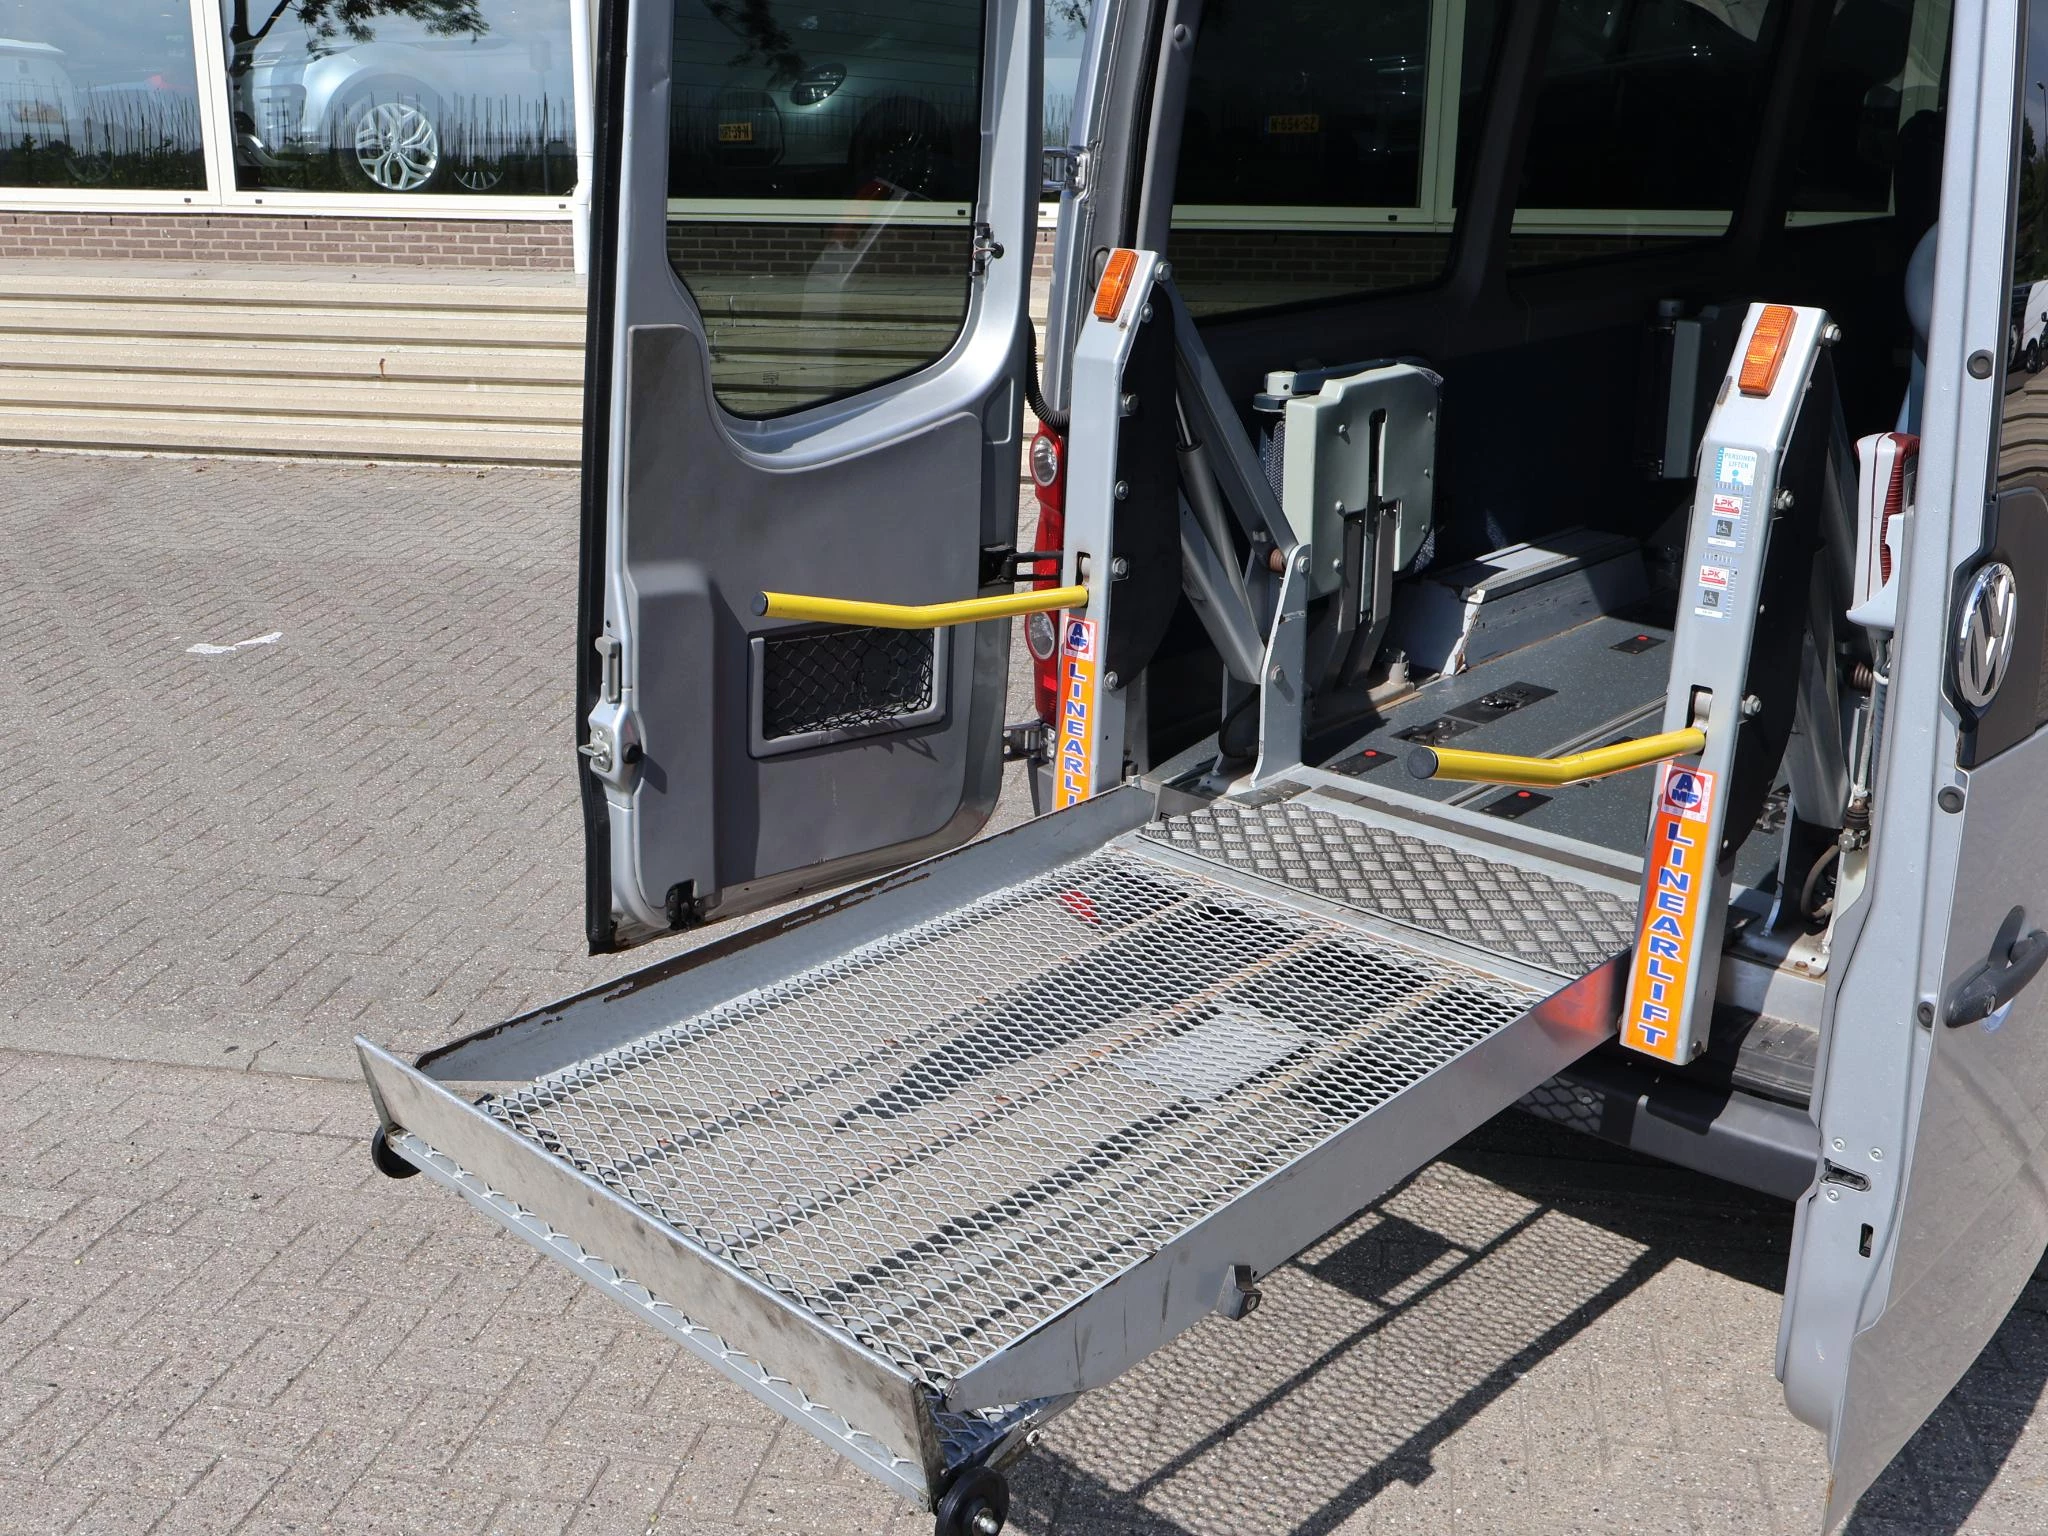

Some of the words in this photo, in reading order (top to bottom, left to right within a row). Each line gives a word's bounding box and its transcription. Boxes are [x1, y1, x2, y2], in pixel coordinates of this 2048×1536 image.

[1724, 452, 1756, 462] PERSONEN
[1728, 461, 1749, 469] LIFTEN
[1715, 498, 1733, 507] LPK
[1702, 569, 1721, 578] LPK
[1672, 773, 1699, 804] AMF
[1637, 821, 1693, 1047] LINEARLIFT
